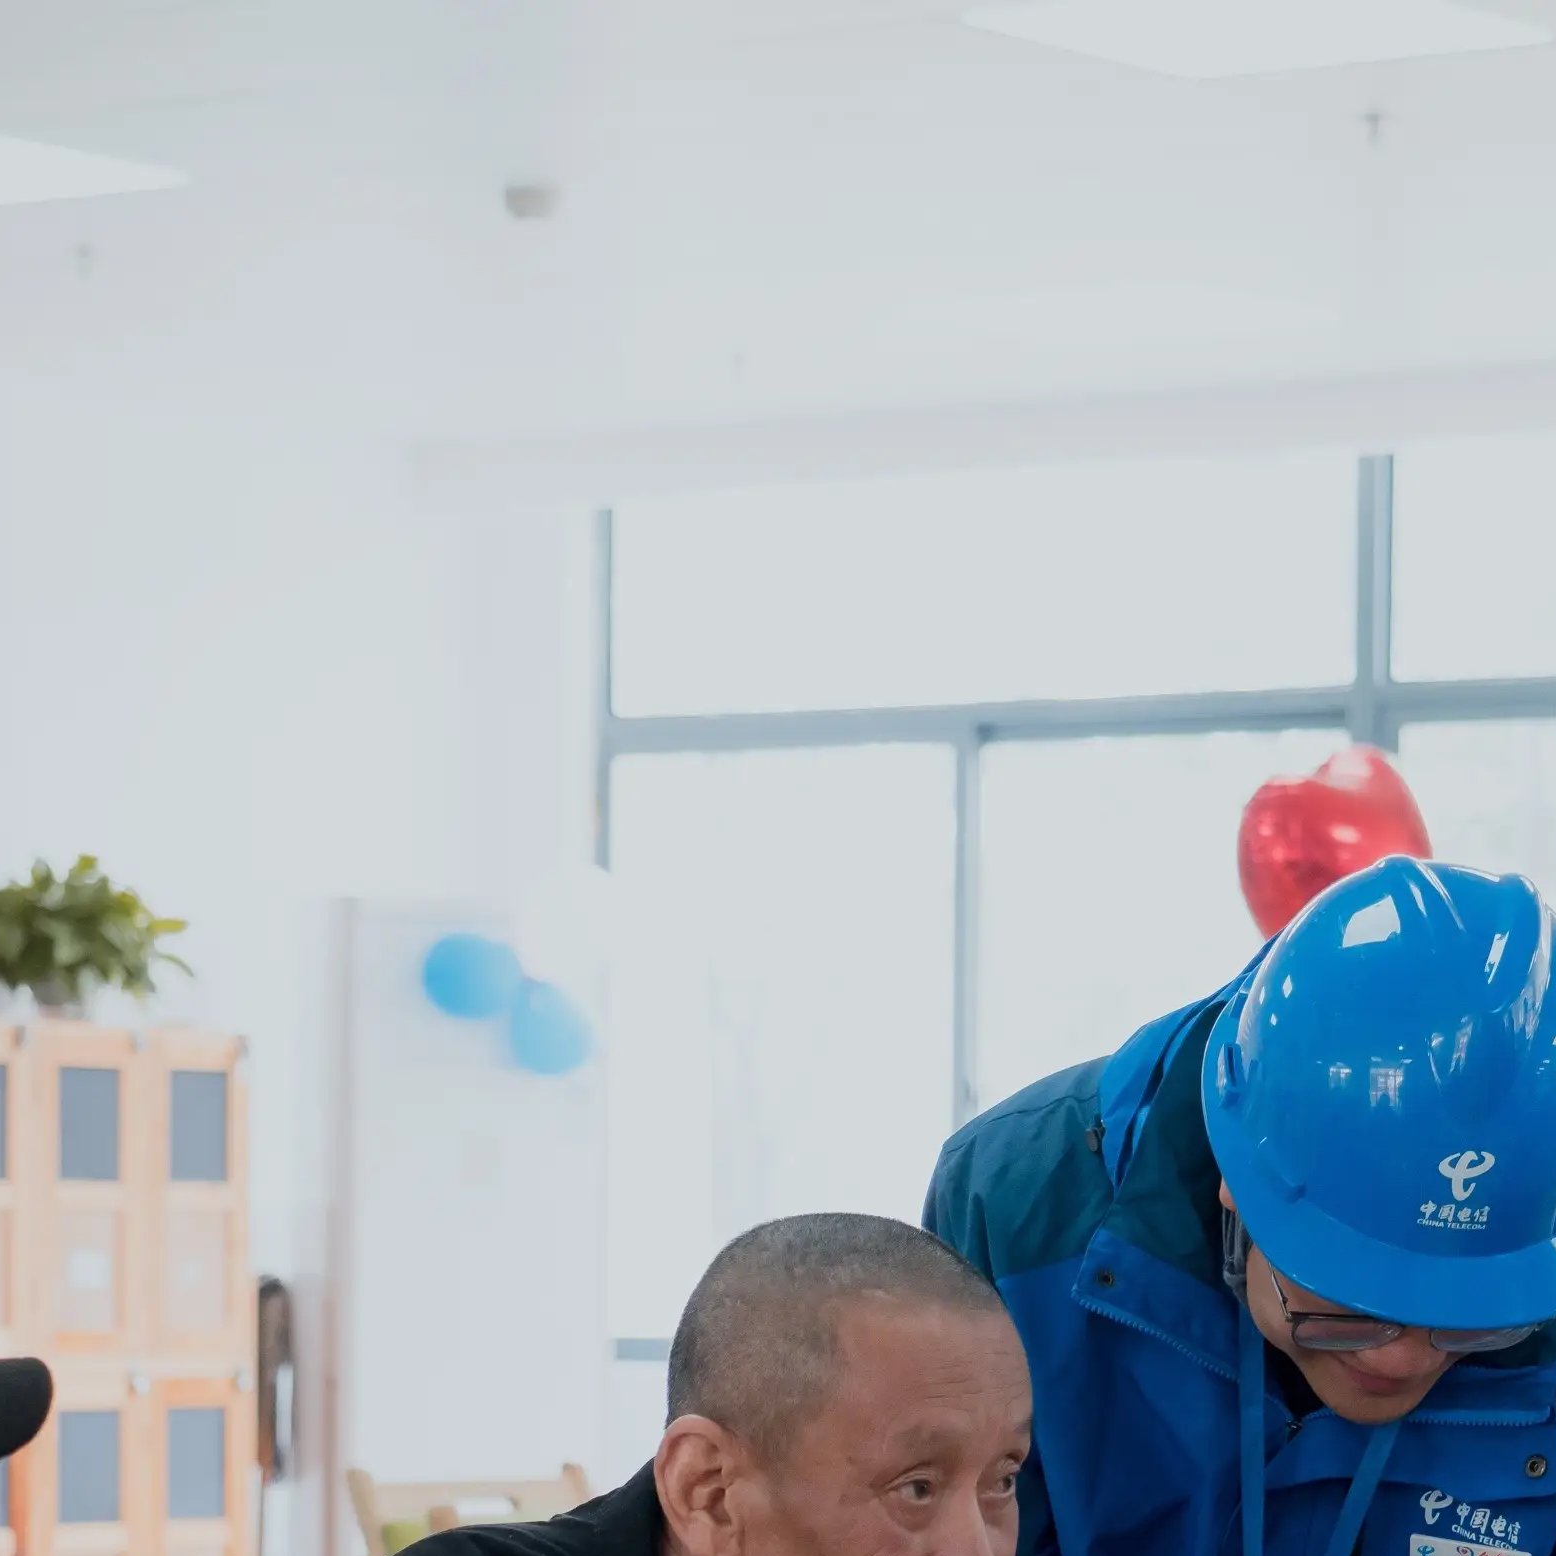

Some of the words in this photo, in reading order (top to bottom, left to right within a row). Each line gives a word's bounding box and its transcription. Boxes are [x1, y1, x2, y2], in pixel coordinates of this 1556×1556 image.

[1419, 1200, 1490, 1222] 中国电信
[1417, 1218, 1444, 1228] CHINA
[1447, 1222, 1486, 1230] TELECOM
[1456, 1502, 1521, 1545] 中国电信
[1451, 1524, 1476, 1541] CHINA
[1478, 1535, 1517, 1552] TELECO
